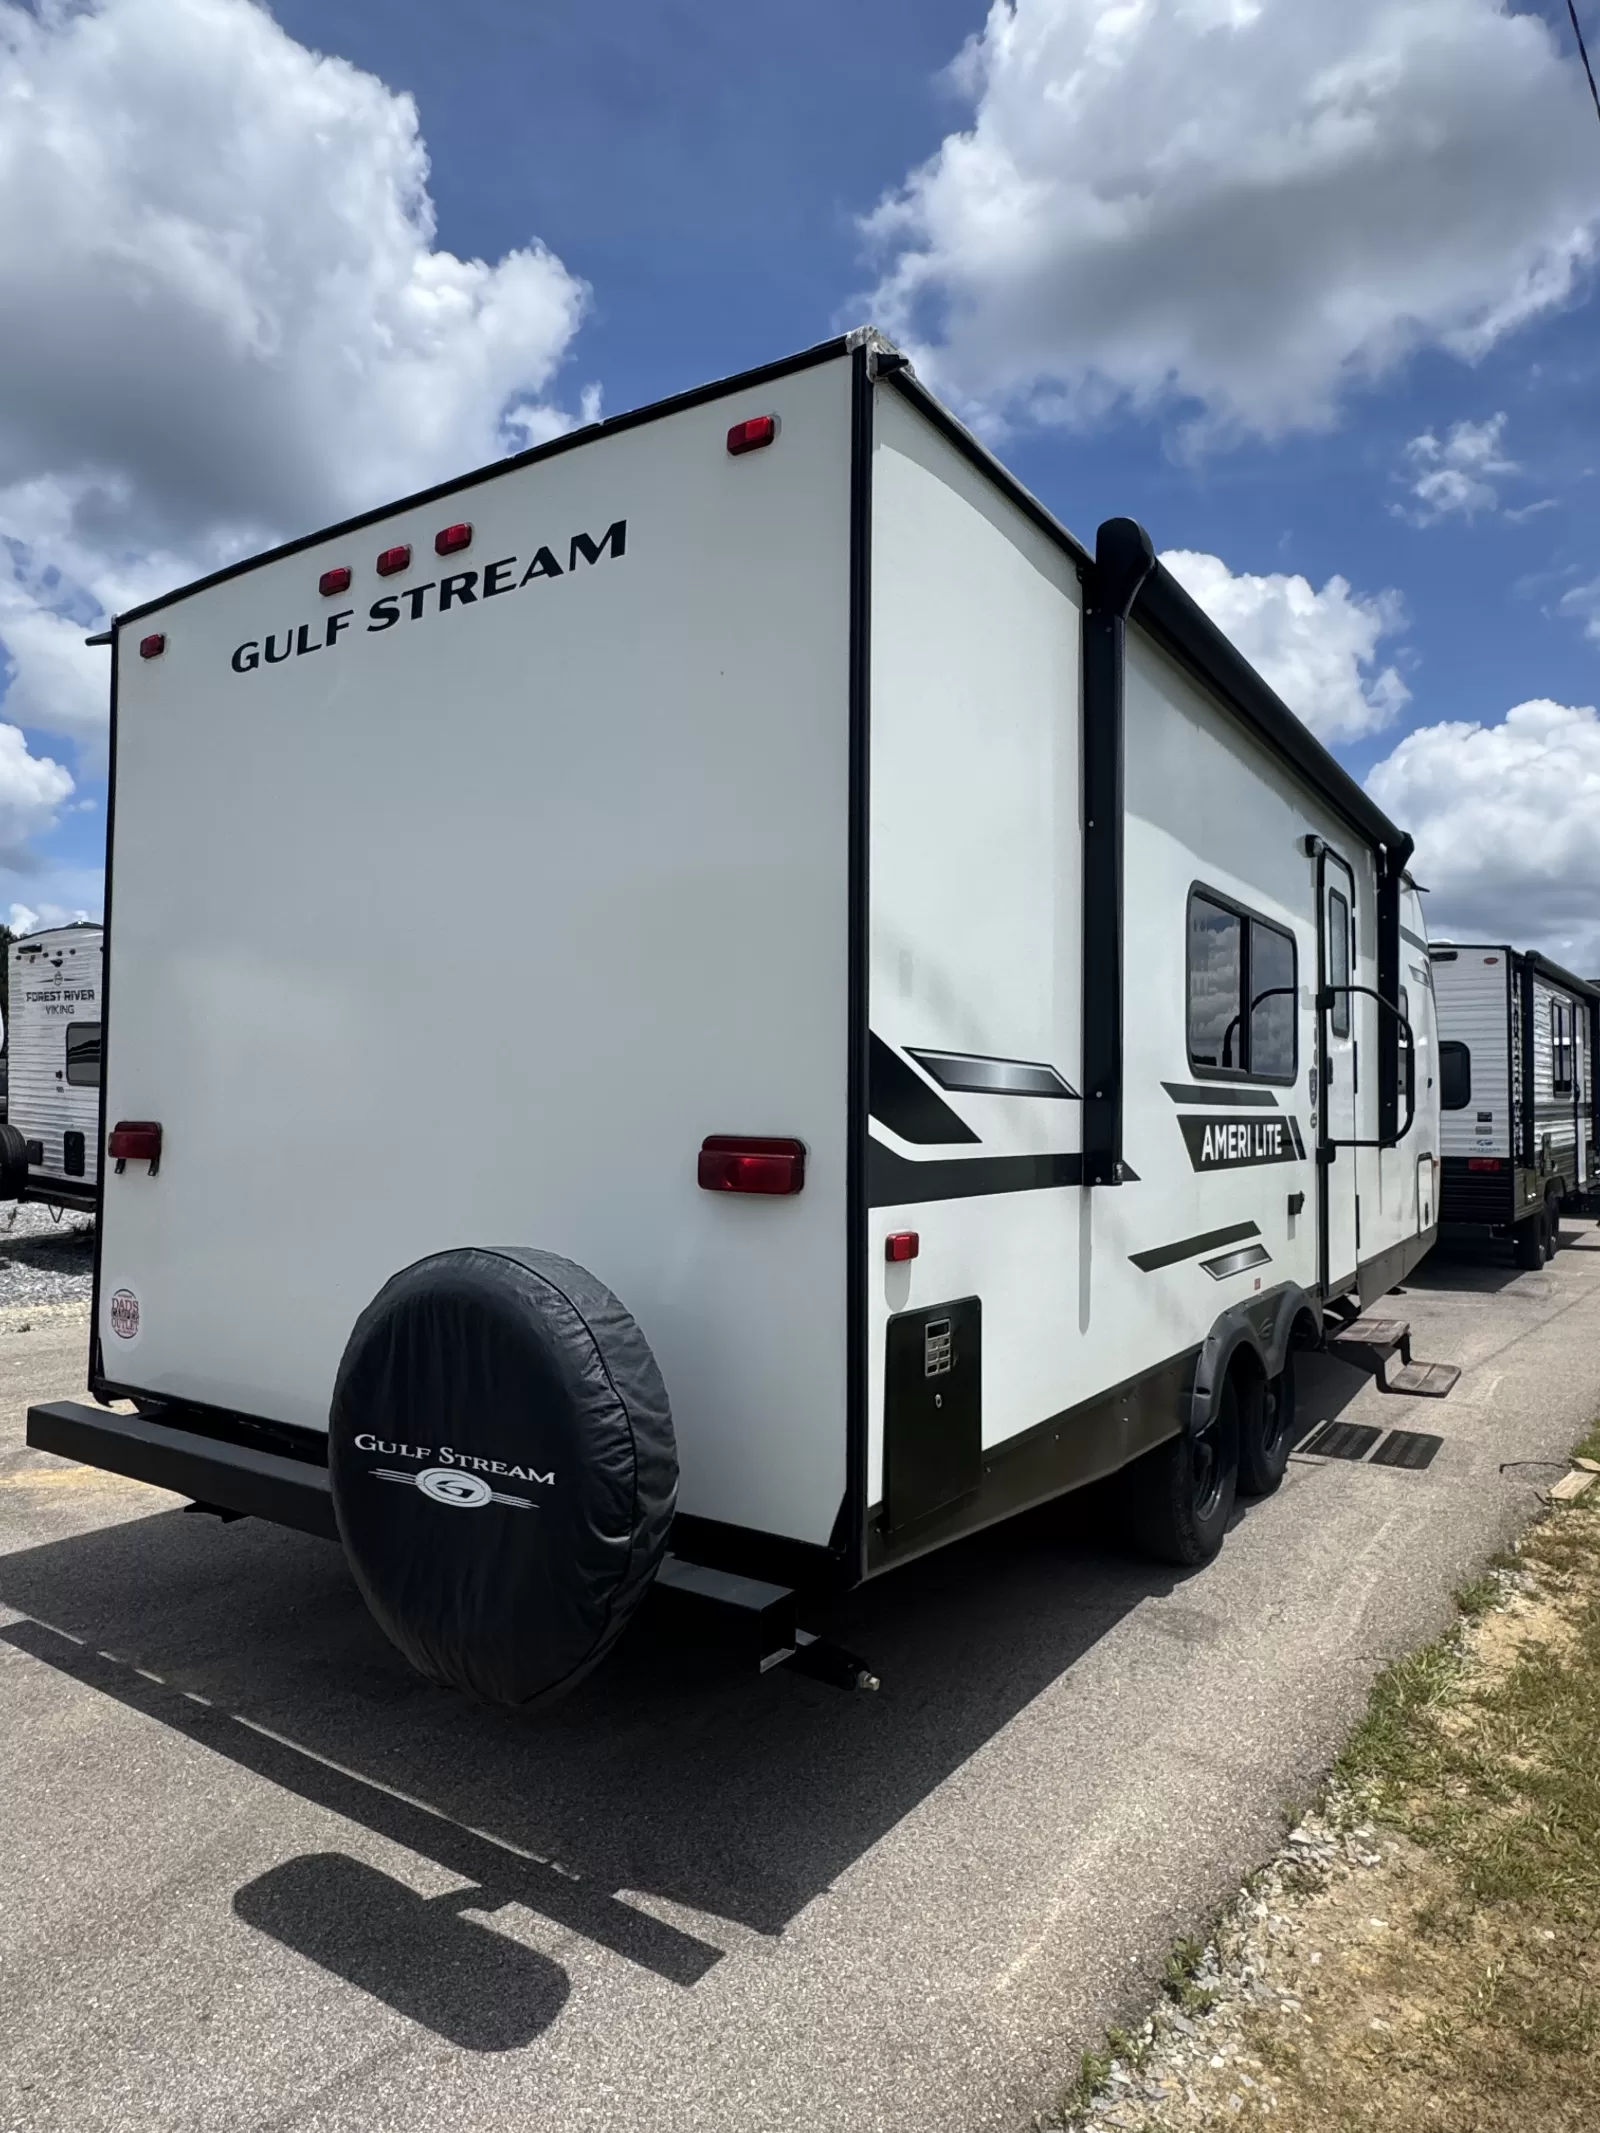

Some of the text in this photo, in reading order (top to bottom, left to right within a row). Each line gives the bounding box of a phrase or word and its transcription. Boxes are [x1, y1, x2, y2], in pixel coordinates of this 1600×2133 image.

[231, 519, 628, 673] GULF STREAM
[26, 989, 94, 1002] FOREST RIVER
[45, 1004, 75, 1015] VIKING
[1201, 1123, 1282, 1161] AMERI LITE
[112, 1298, 138, 1312] DADS
